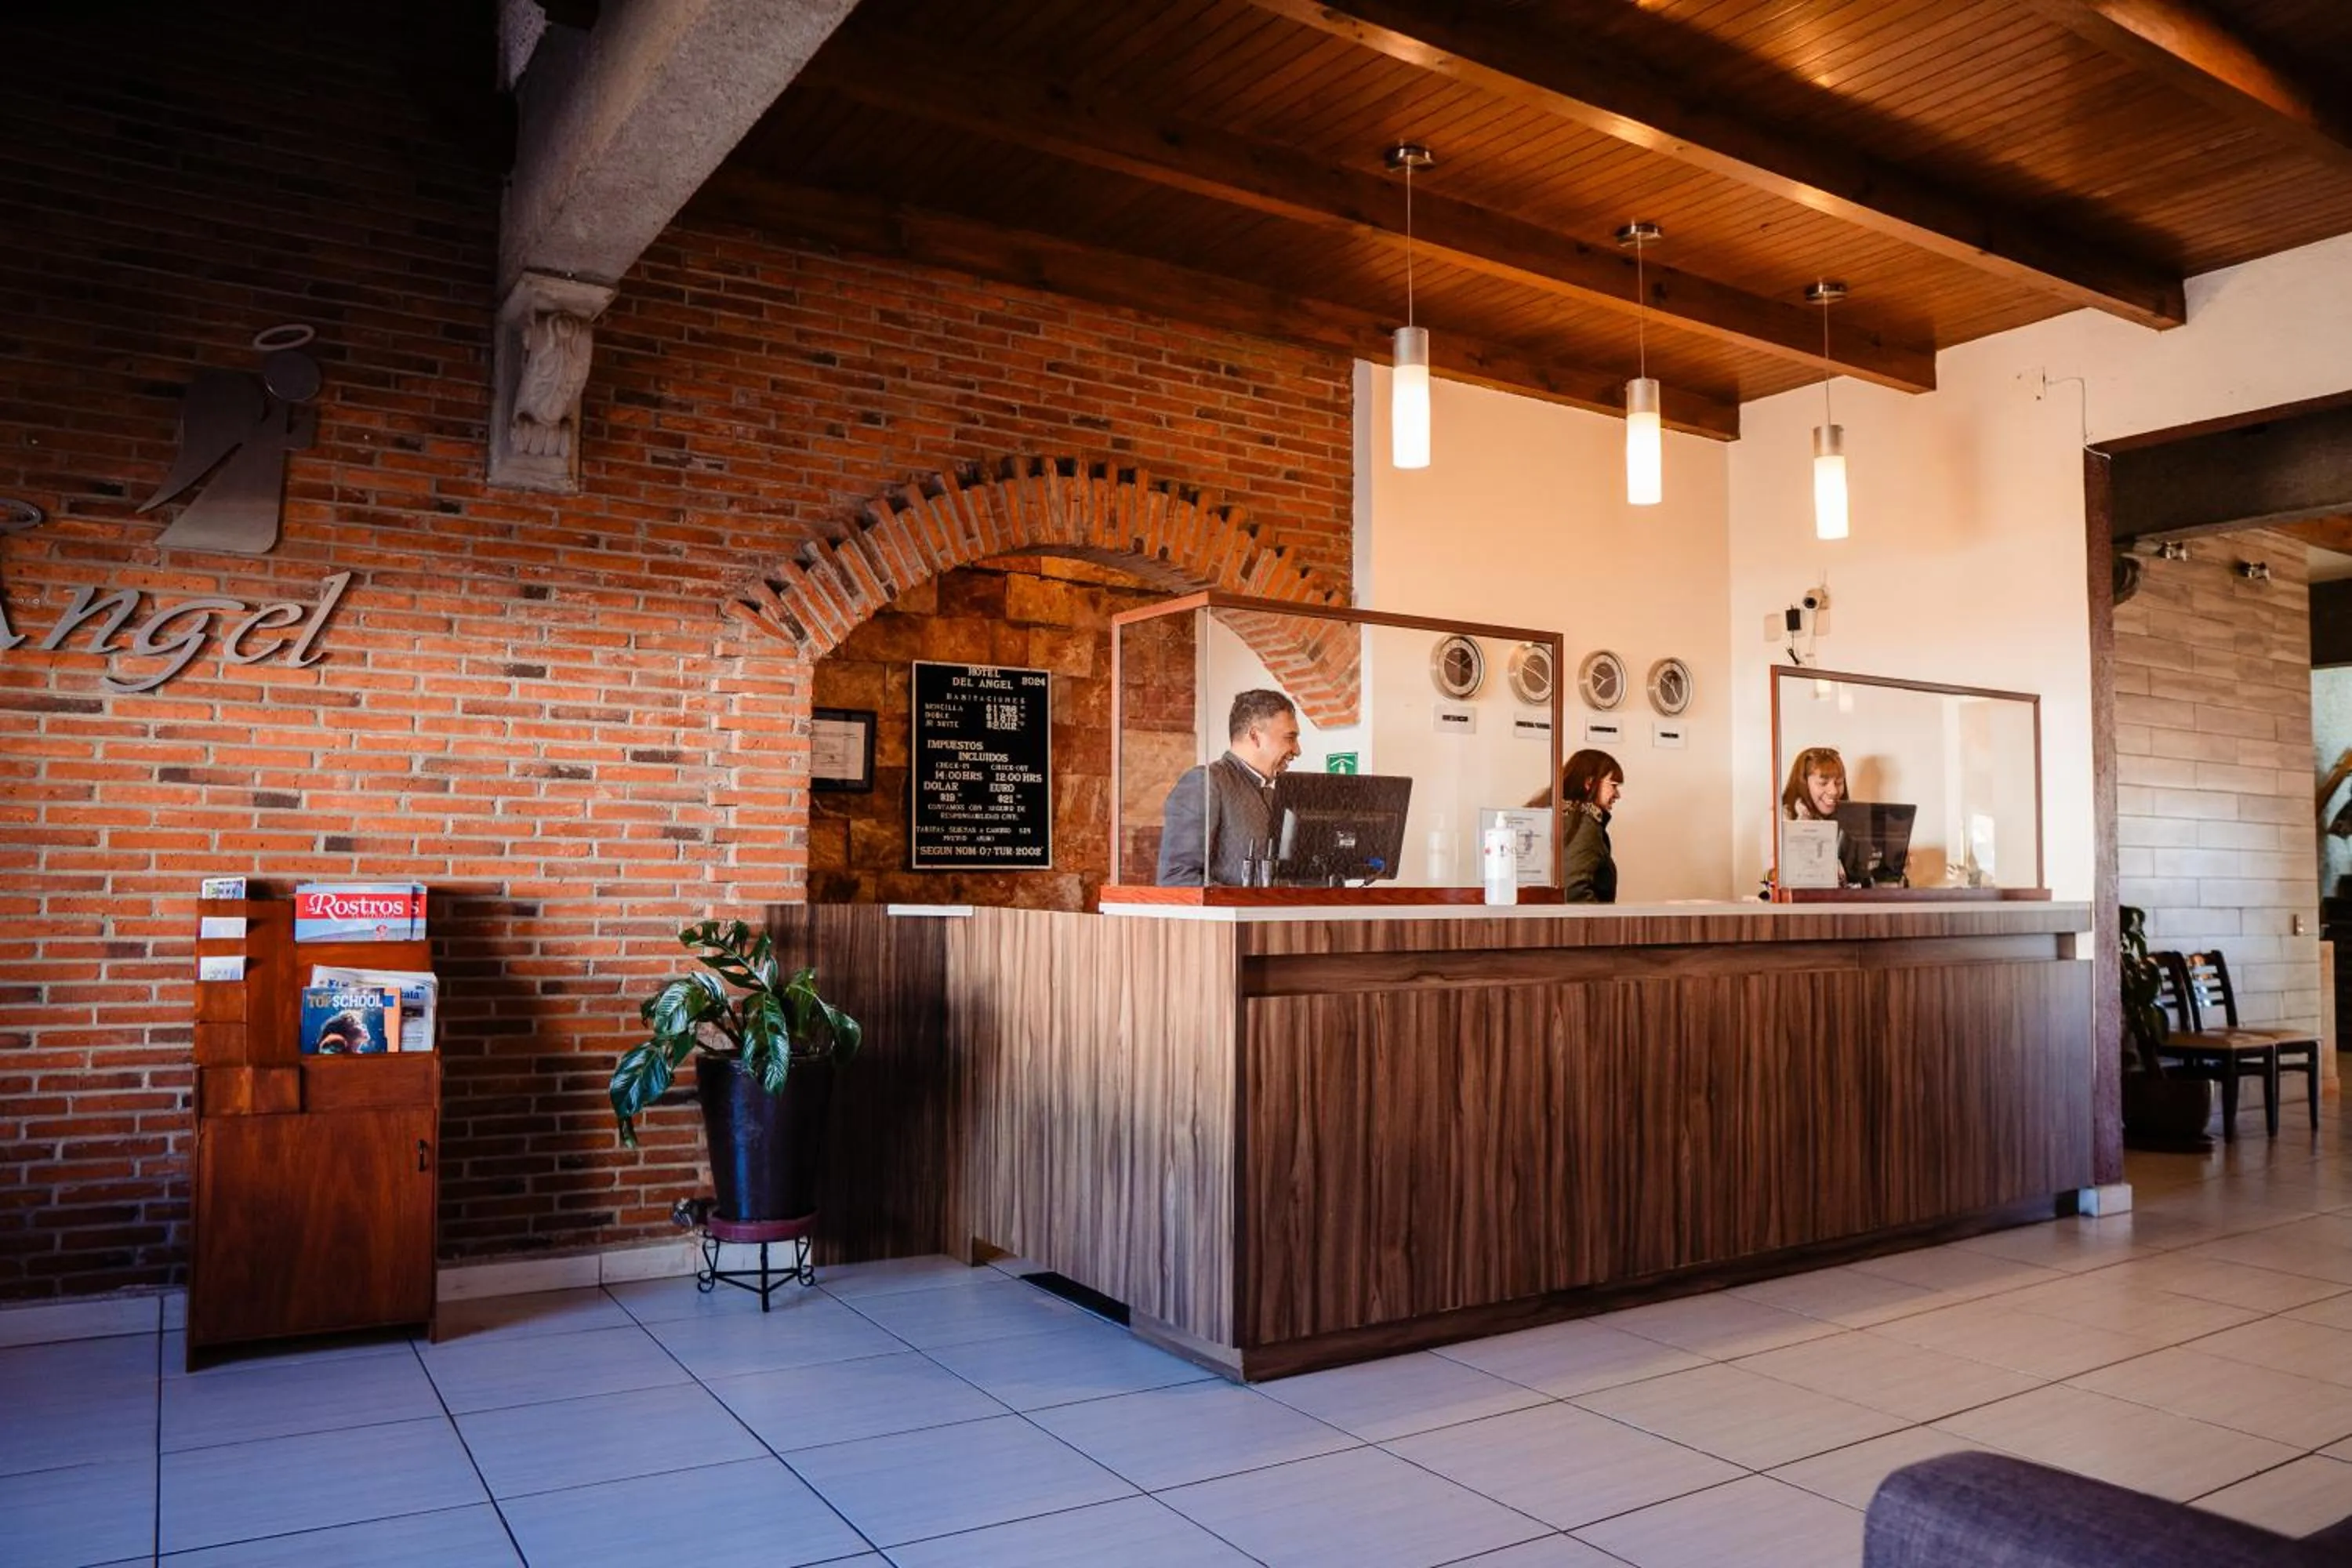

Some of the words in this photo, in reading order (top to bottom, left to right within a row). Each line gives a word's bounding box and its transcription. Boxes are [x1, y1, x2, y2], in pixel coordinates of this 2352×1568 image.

[967, 667, 1000, 677] HOTEL
[952, 677, 974, 687] DEL
[978, 679, 1014, 690] ANGEL
[946, 692, 1025, 704] HABITACIONES
[927, 739, 984, 750] IMPUESTOS
[958, 752, 1009, 763] INCLUIDOS
[924, 780, 959, 791] DOLAR
[989, 783, 1015, 793] EURO
[310, 893, 404, 921] Rostros
